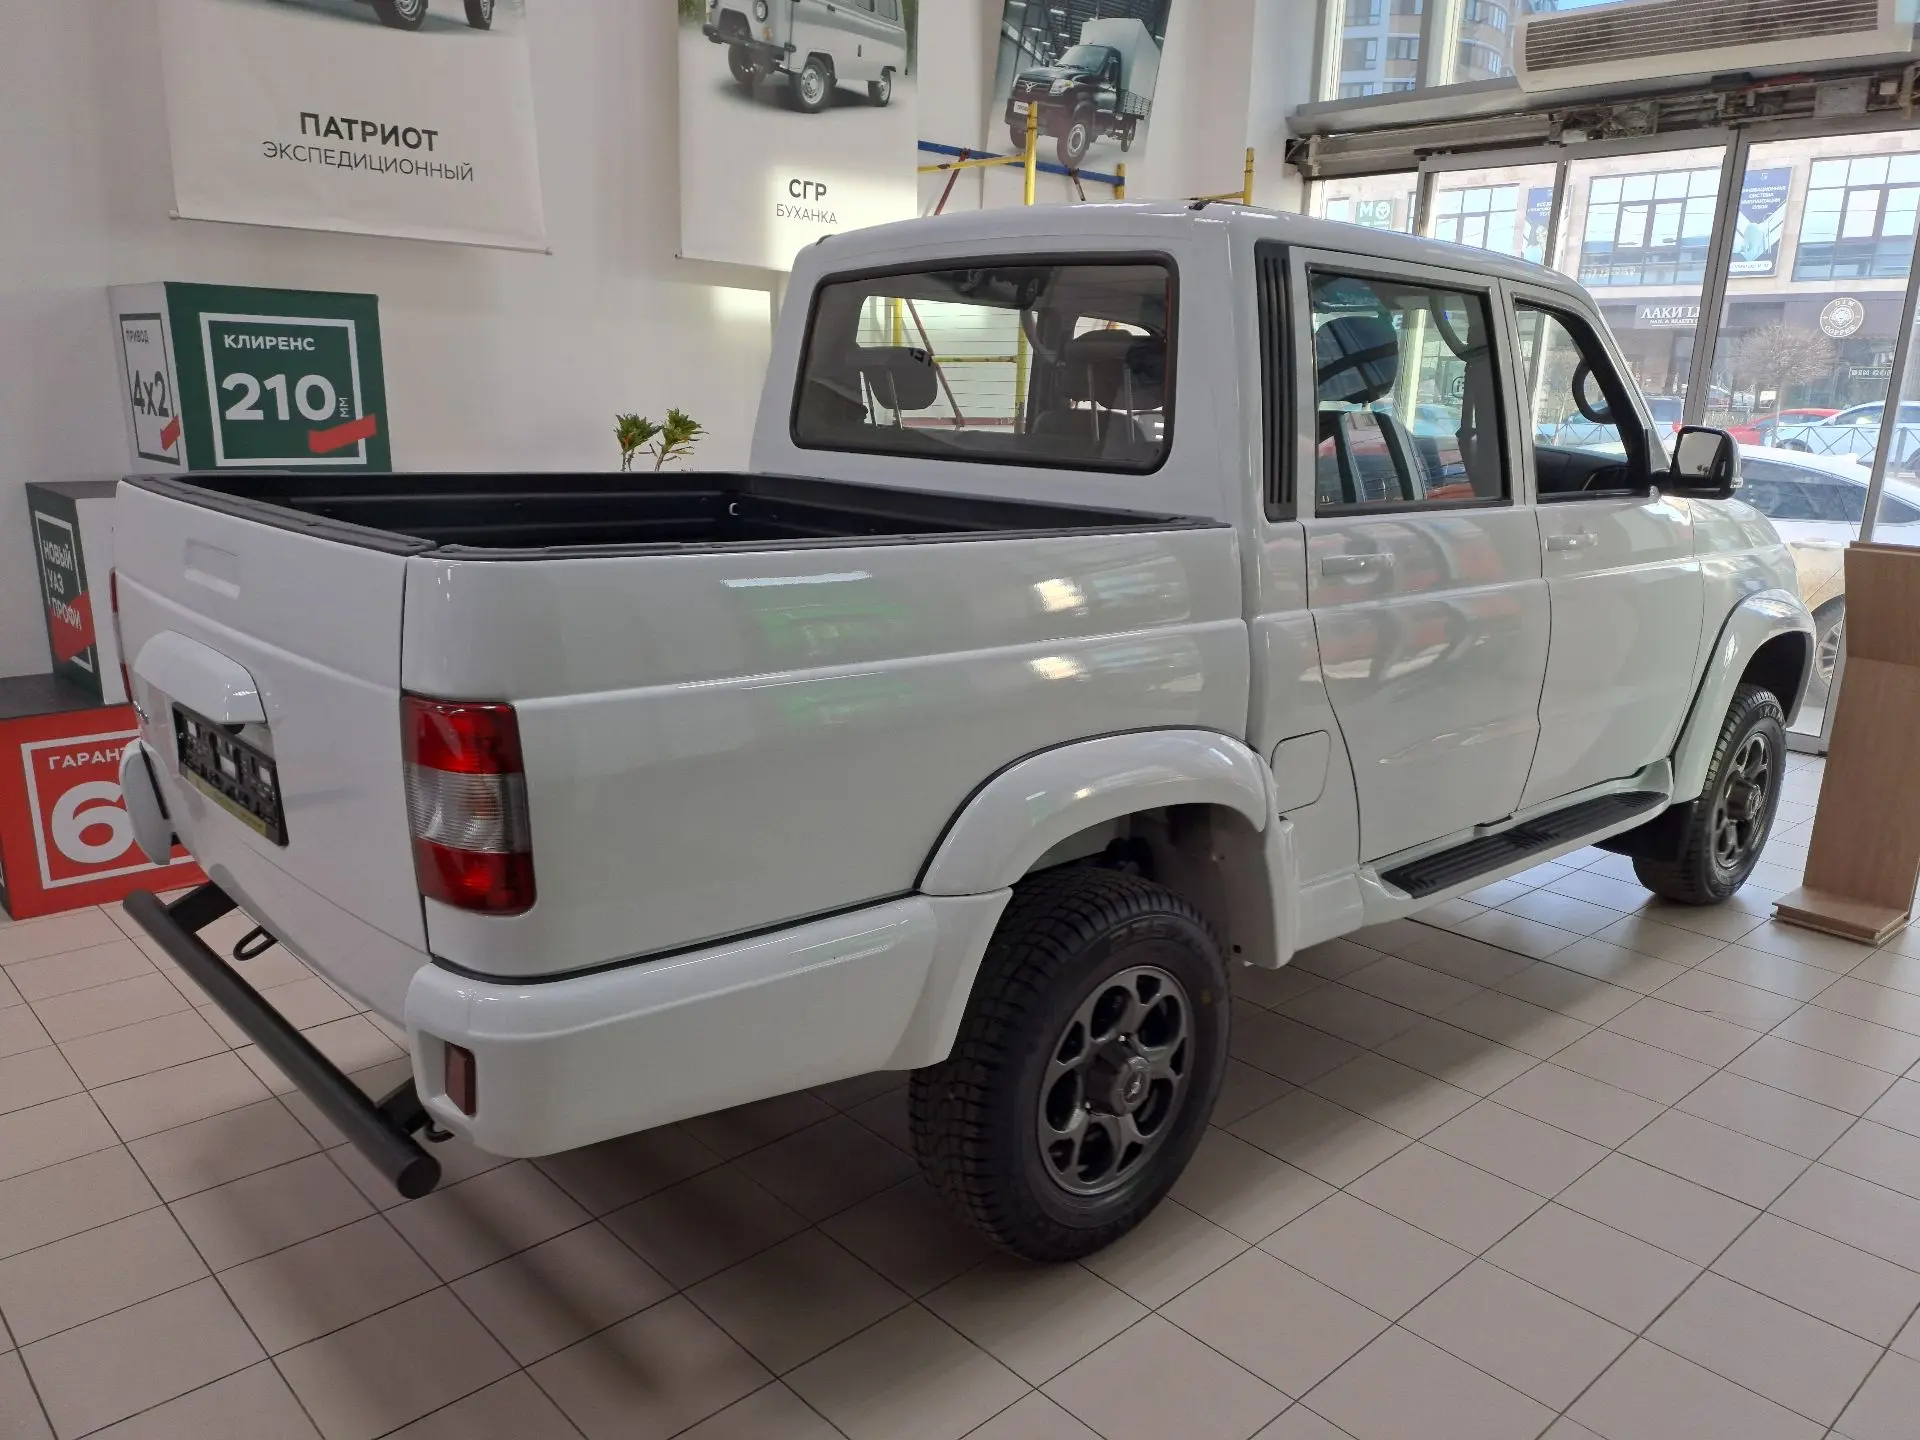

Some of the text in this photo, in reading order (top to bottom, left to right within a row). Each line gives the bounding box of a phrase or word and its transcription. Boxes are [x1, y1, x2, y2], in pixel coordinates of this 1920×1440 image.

[300, 112, 438, 152] ПАТРИОТ
[263, 140, 473, 182] ЭКСПЕДИЦИОННЫЙ
[788, 178, 827, 201] СГР
[776, 203, 838, 224] БУХАНКА
[223, 334, 316, 351] КЛИРЕНС
[133, 369, 169, 418] 4x2
[221, 372, 337, 421] 210
[43, 540, 73, 571] НОВЫЙ
[47, 567, 64, 595] УАЗ
[51, 597, 82, 630] ПРОФИ
[52, 781, 135, 864] 6
